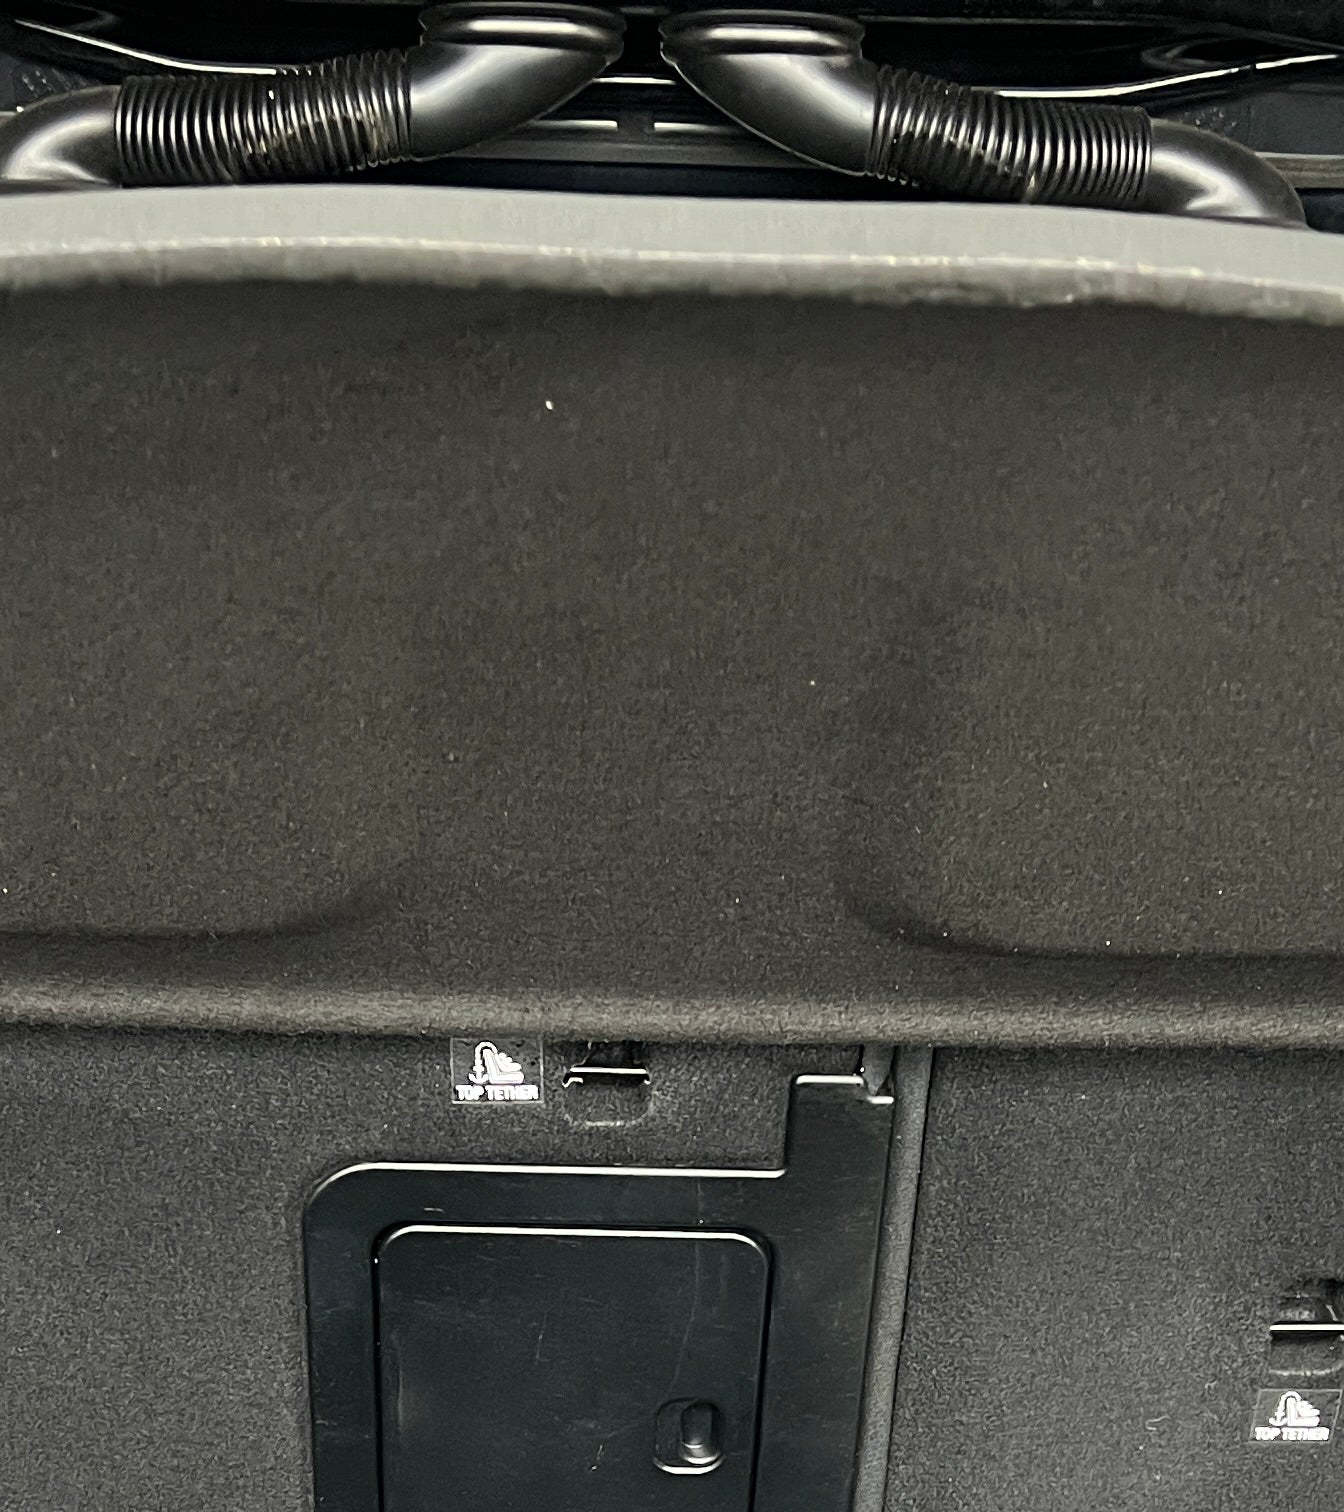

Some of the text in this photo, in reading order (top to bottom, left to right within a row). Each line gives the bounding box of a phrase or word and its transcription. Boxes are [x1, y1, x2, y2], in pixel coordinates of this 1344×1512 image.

[455, 1085, 538, 1100] TOP TETHER
[1255, 1427, 1330, 1440] TOP TETHER
